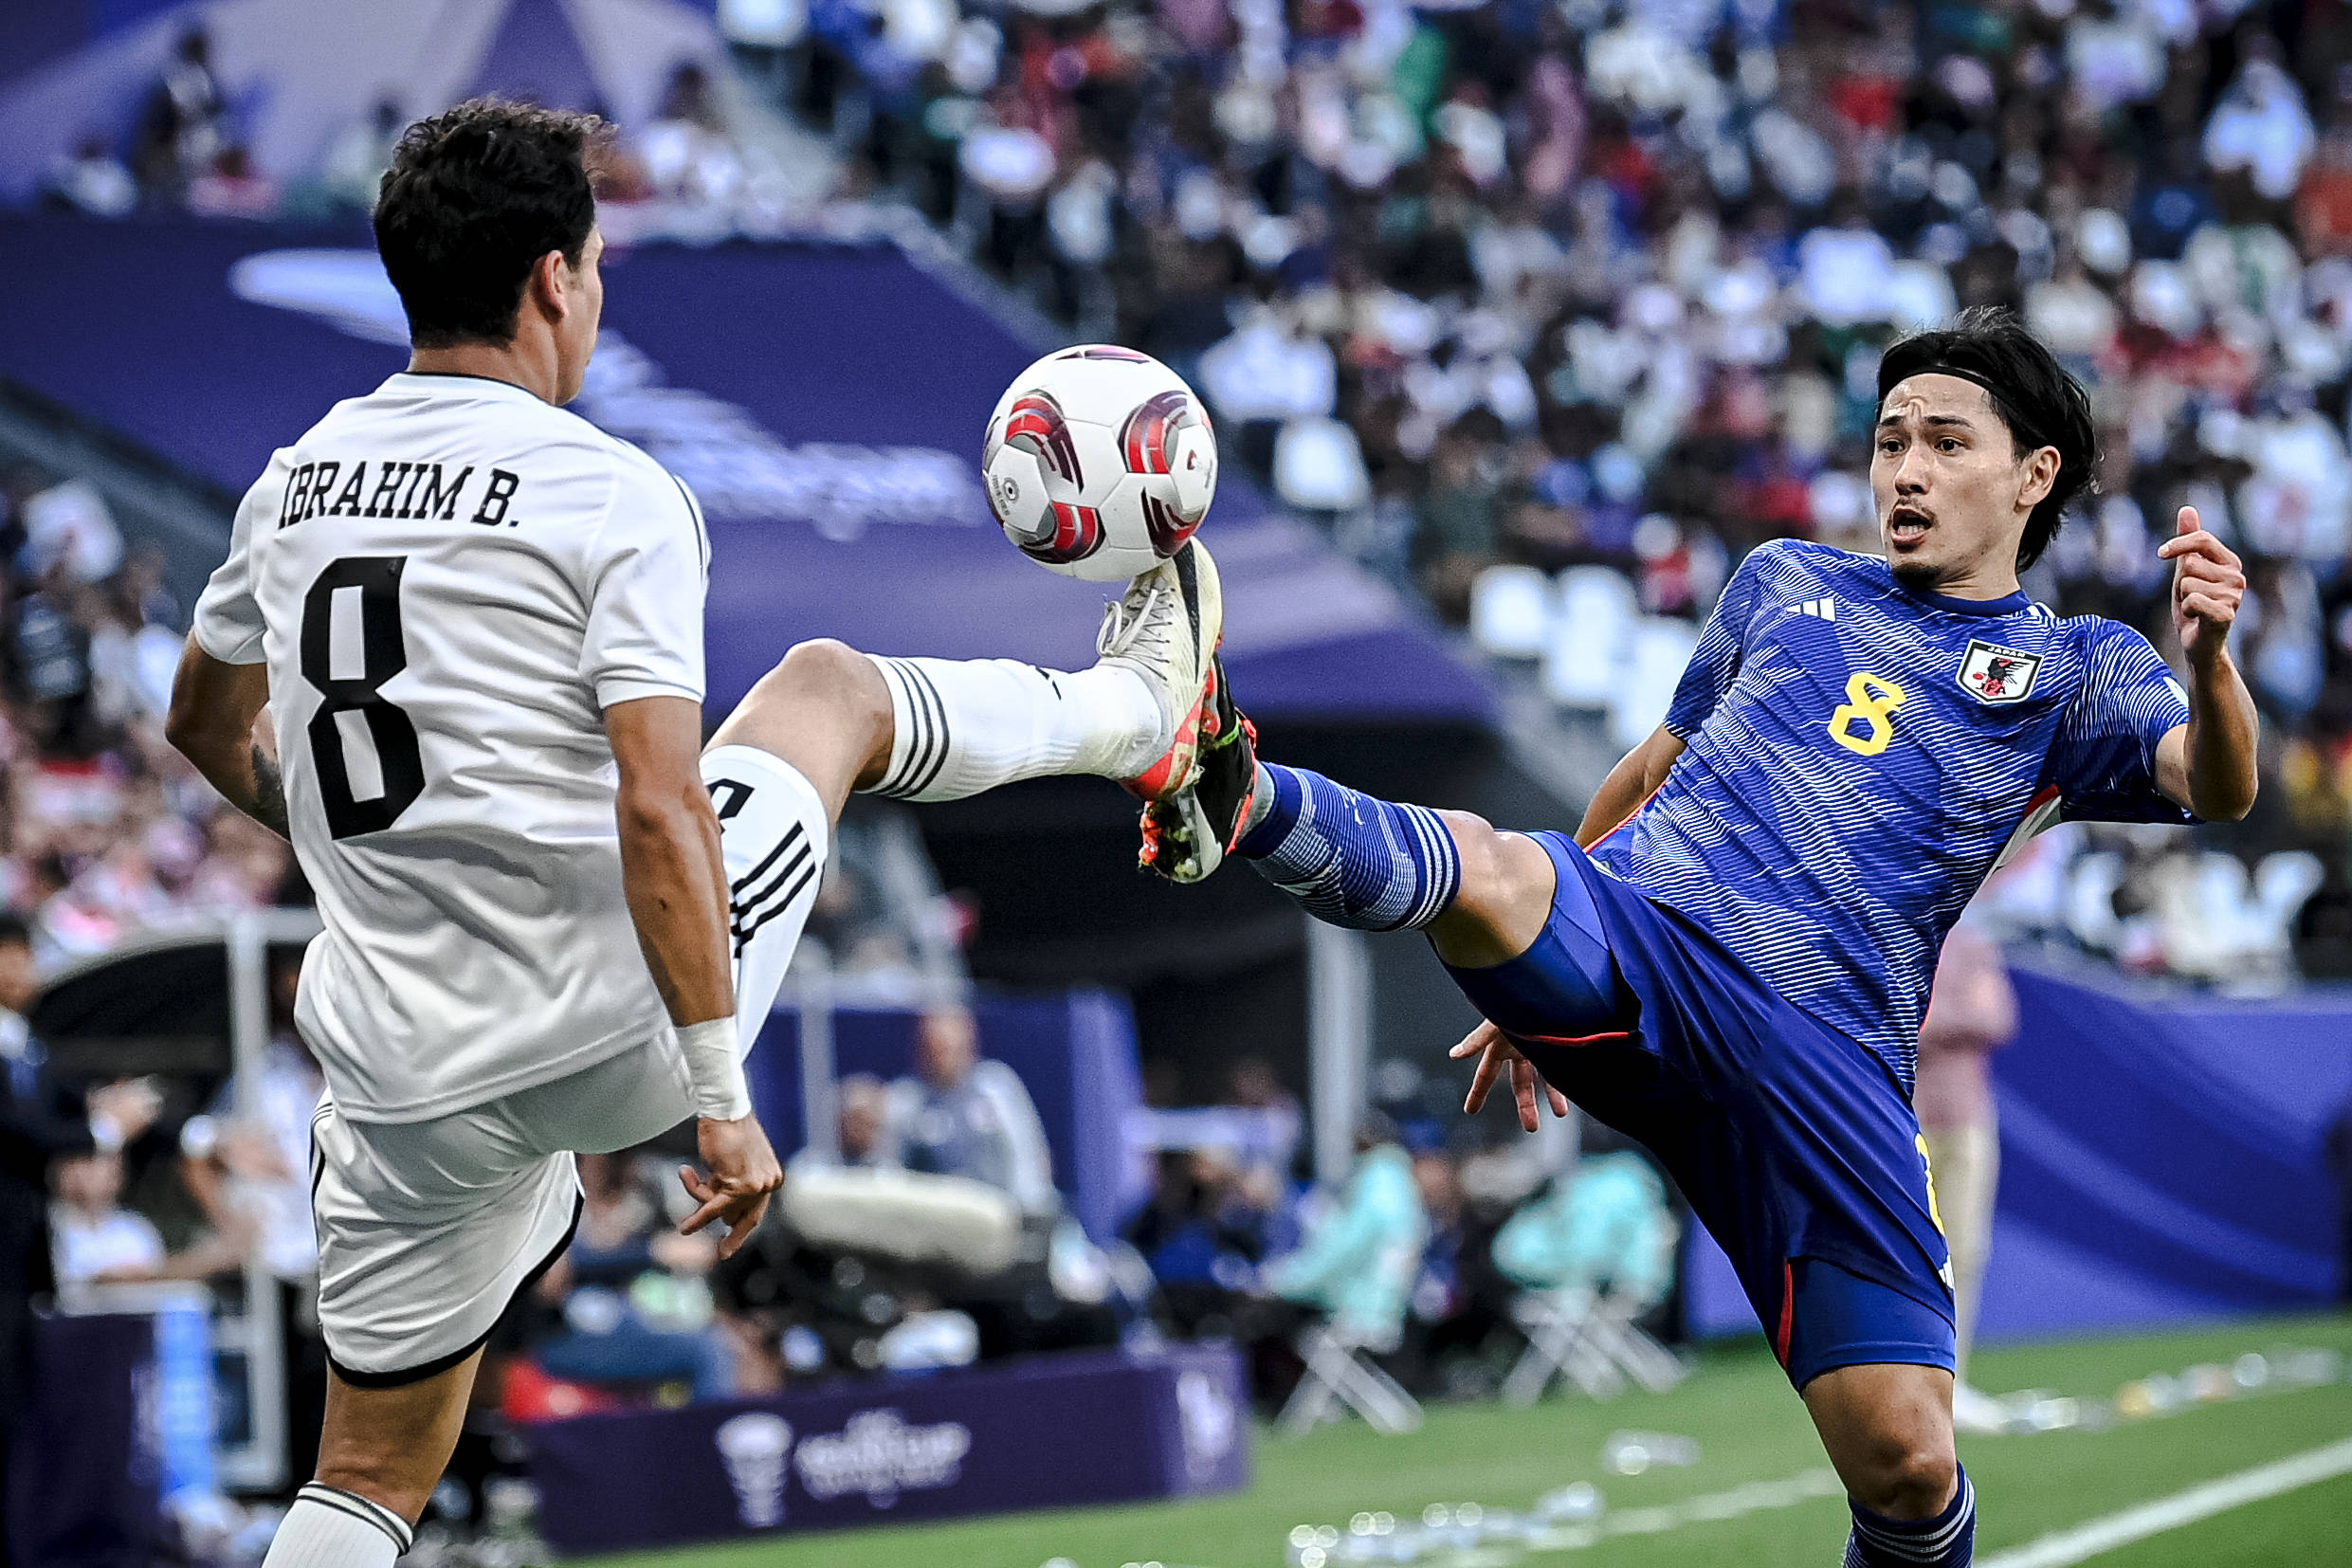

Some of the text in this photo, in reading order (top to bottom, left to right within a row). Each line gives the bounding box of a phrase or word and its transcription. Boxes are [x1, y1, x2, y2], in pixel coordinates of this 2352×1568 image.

[278, 461, 520, 530] IBRAHIM B.
[1987, 647, 2026, 658] JAPAN
[300, 556, 426, 841] 8
[1827, 672, 1907, 757] 8
